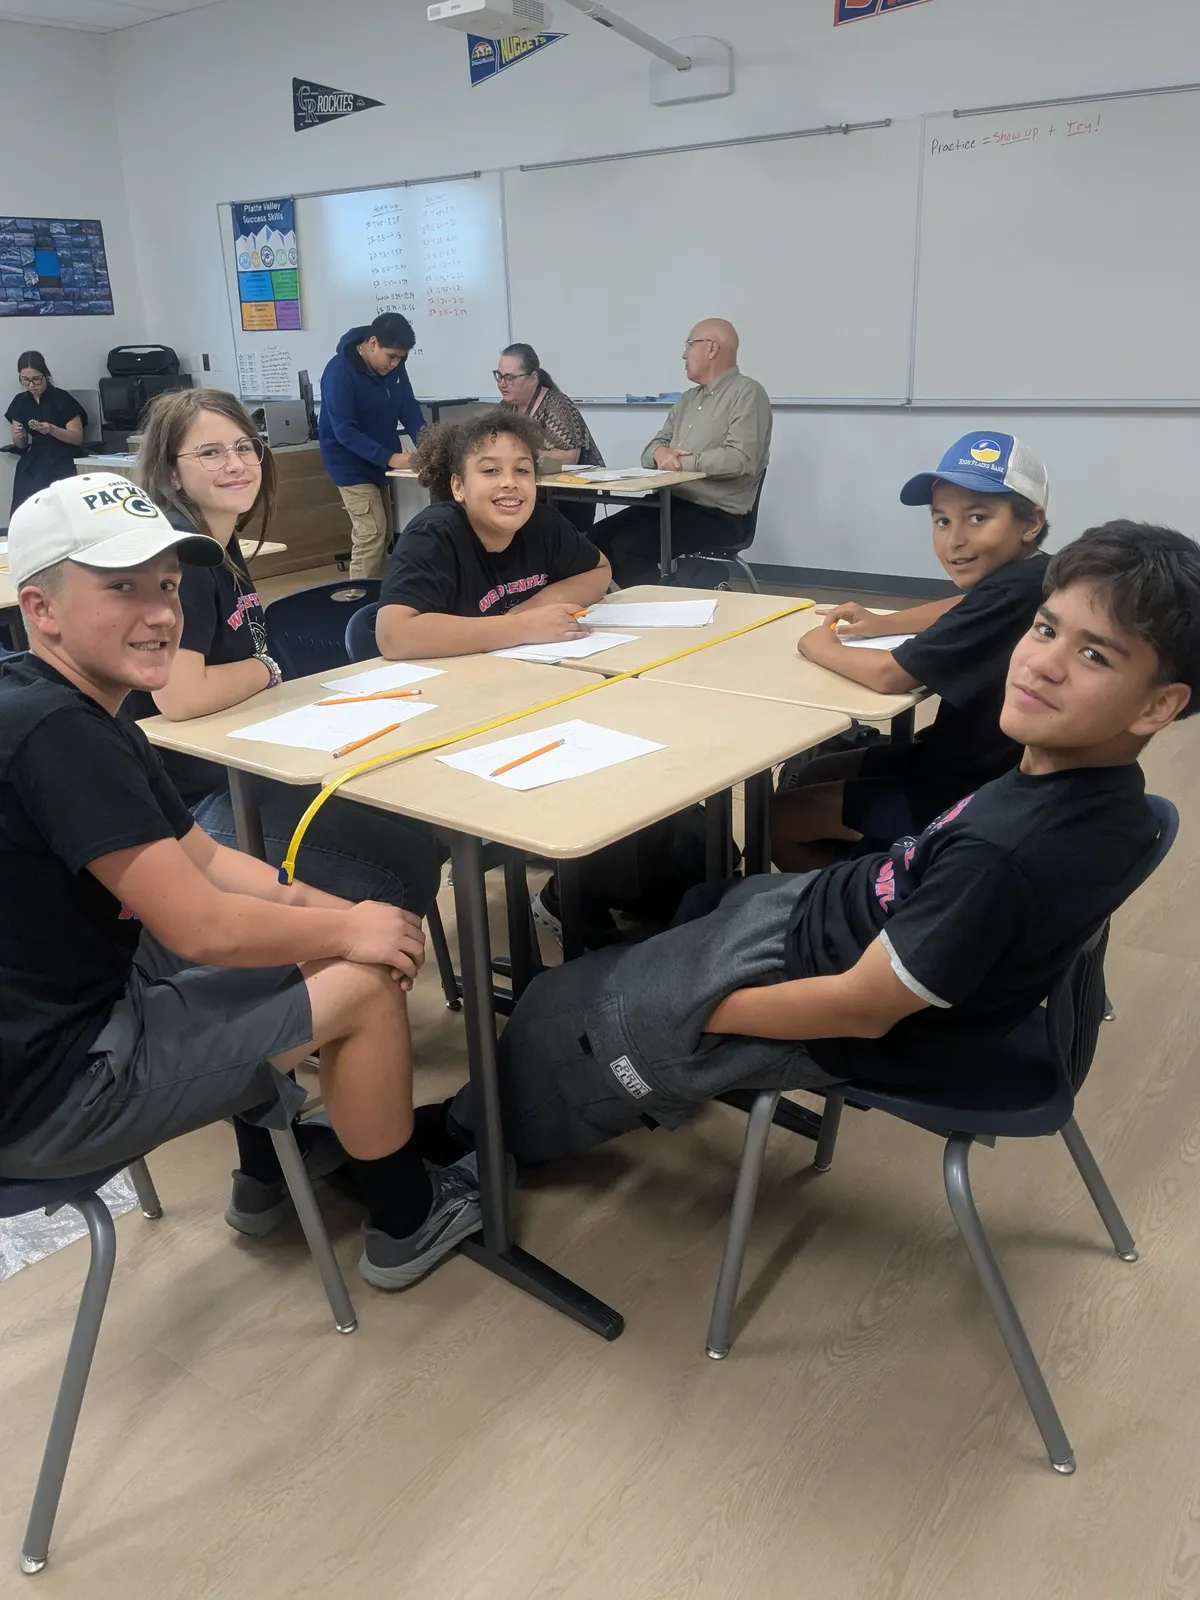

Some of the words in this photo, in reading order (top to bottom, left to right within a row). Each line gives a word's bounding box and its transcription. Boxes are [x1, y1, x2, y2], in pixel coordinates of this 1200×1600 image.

[500, 35, 547, 64] NUGGETS
[317, 94, 354, 112] ROCKIES
[931, 138, 976, 155] Practice
[243, 203, 263, 213] Platte
[263, 201, 281, 211] Valley
[242, 213, 267, 224] Success
[267, 212, 284, 221] Skills
[990, 463, 1005, 473] BANK
[614, 1064, 642, 1096] CLUB
